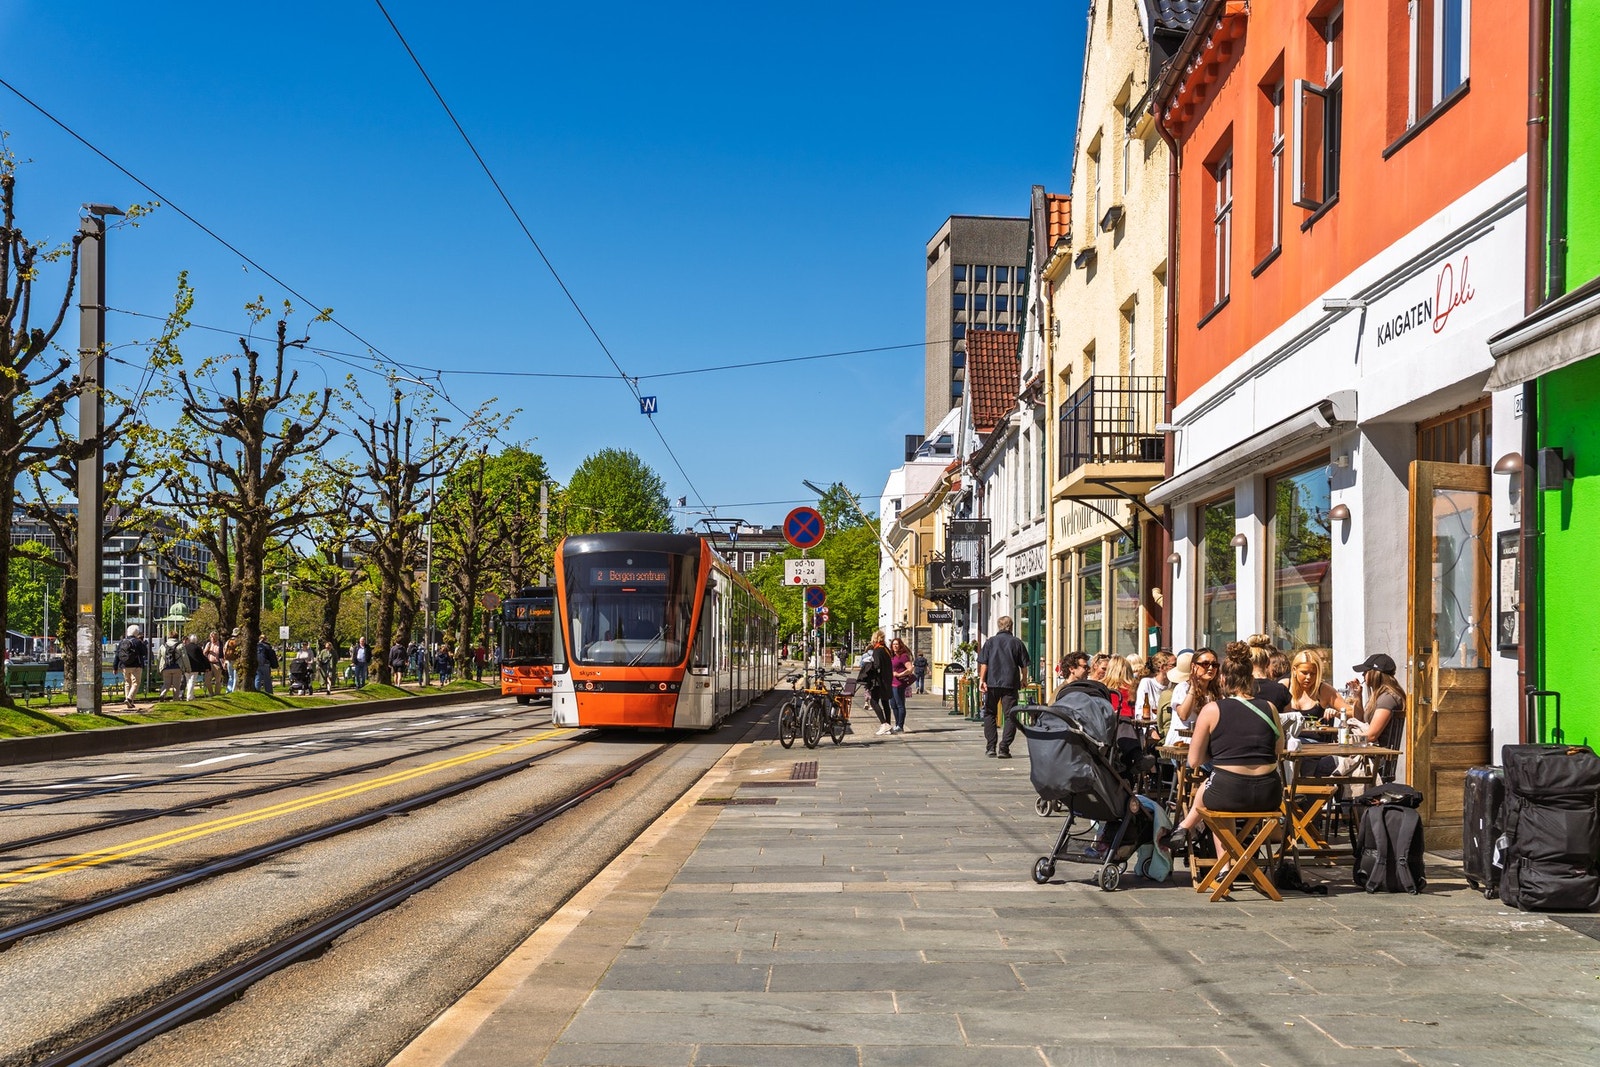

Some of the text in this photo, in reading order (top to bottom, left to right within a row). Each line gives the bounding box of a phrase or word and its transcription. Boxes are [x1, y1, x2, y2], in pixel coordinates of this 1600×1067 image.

[1377, 255, 1475, 347] KAIGATEN Deli
[641, 397, 656, 412] W
[597, 570, 666, 583] 2 Bergen sentrum
[516, 607, 526, 618] 12
